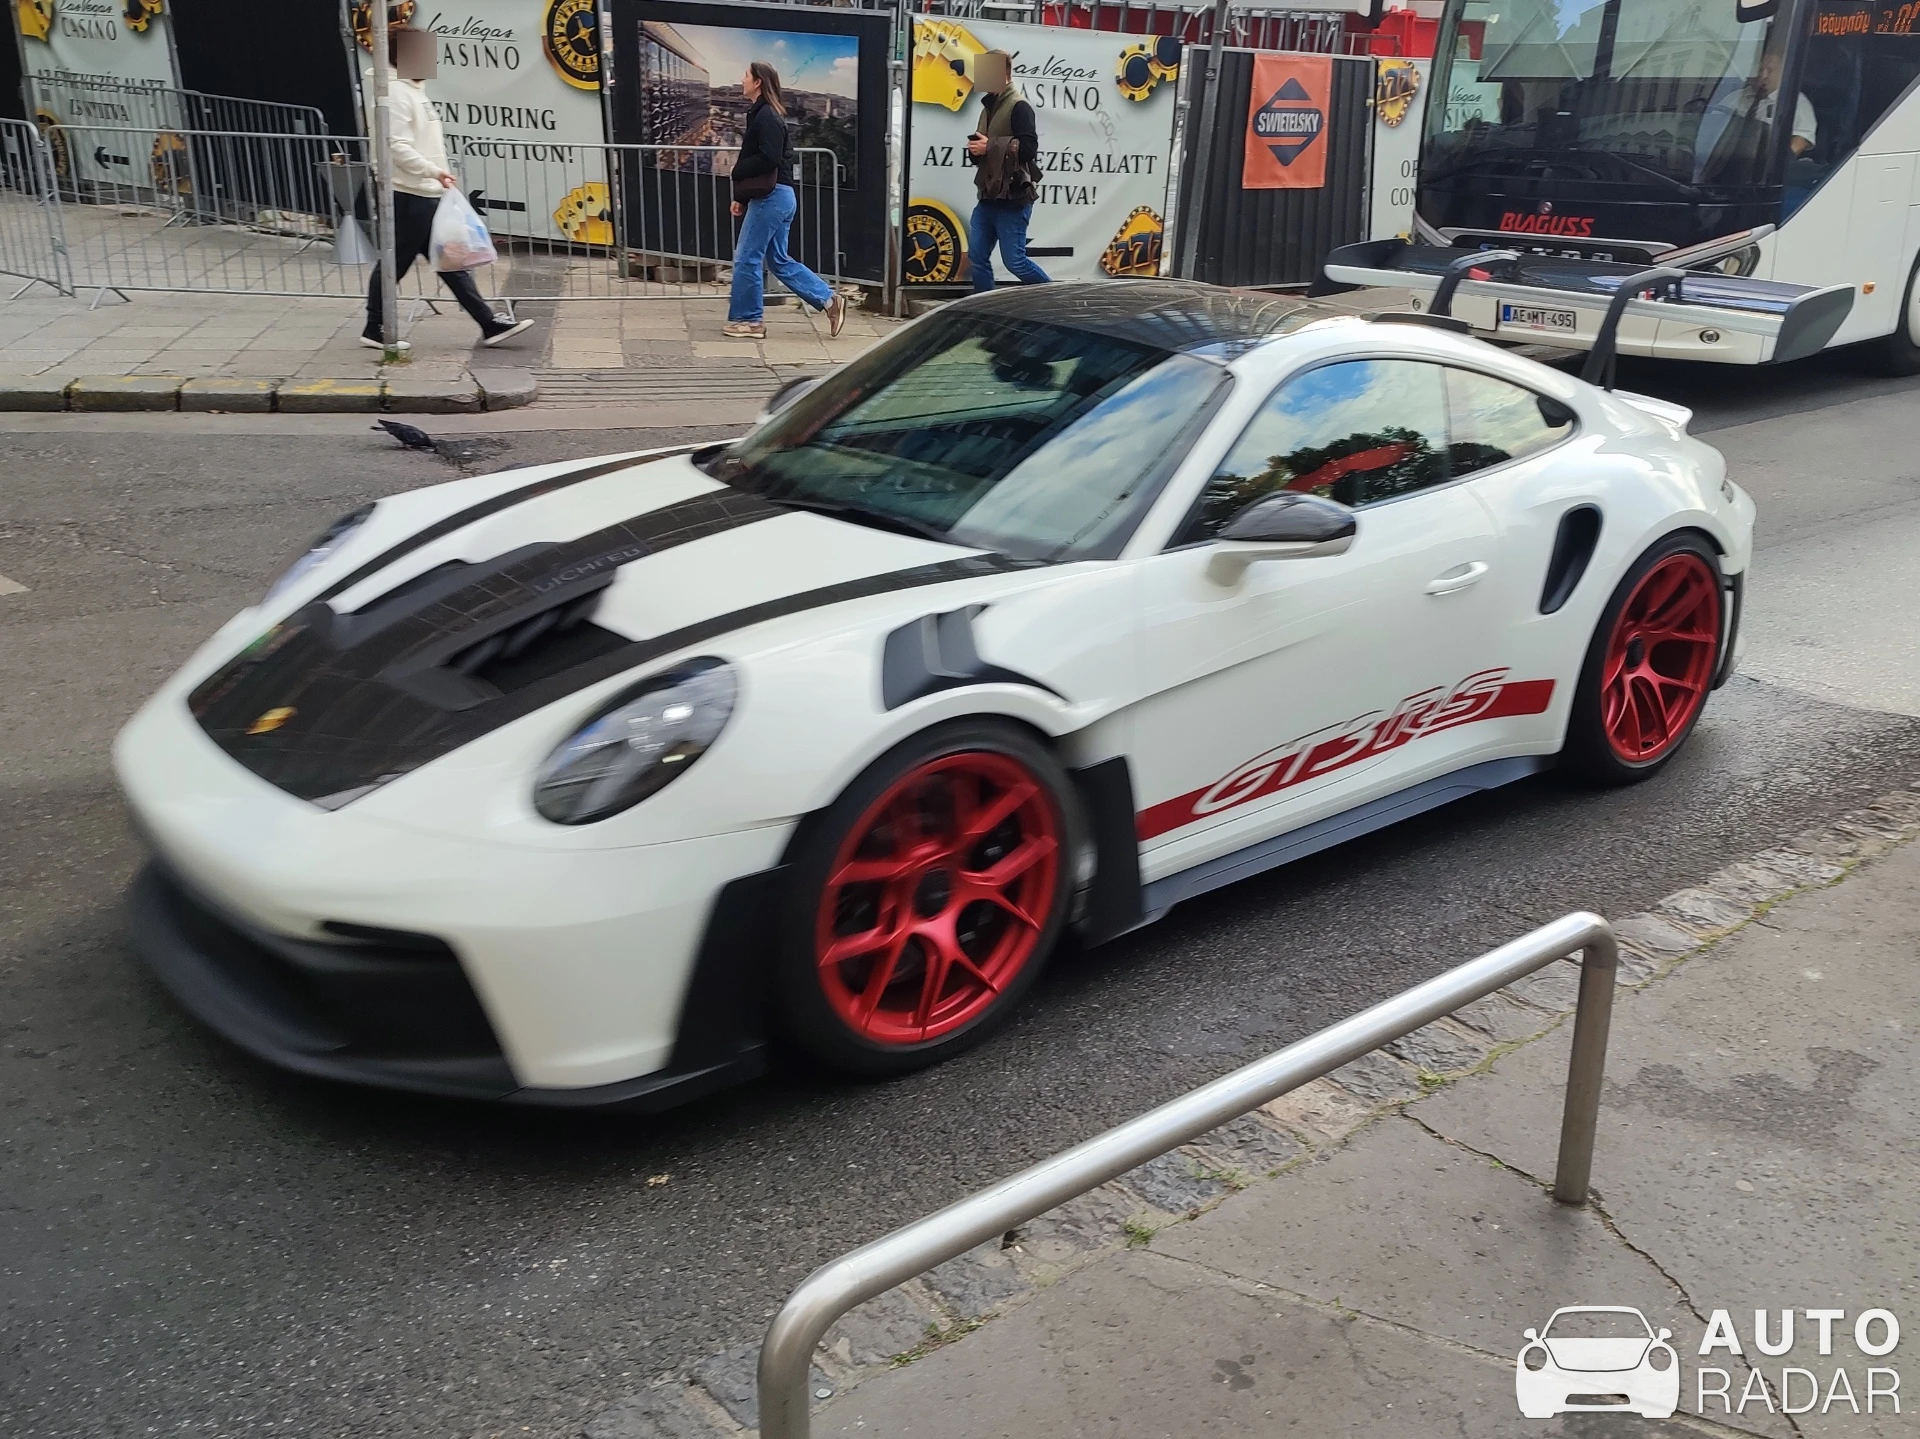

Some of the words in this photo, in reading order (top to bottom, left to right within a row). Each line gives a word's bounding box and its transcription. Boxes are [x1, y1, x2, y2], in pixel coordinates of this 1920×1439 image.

[61, 17, 117, 41] CASINO
[462, 16, 514, 43] Vegas
[436, 42, 520, 70] ASINO
[1042, 55, 1099, 83] Vegas
[1020, 82, 1100, 111] ASINO
[466, 103, 557, 131] DURING
[1257, 112, 1320, 133] SWIETELSKY
[444, 133, 574, 164] TRUCTION!
[922, 146, 954, 168] AZ
[1089, 152, 1158, 175] ALATT
[1500, 212, 1596, 238] BLAGUSS
